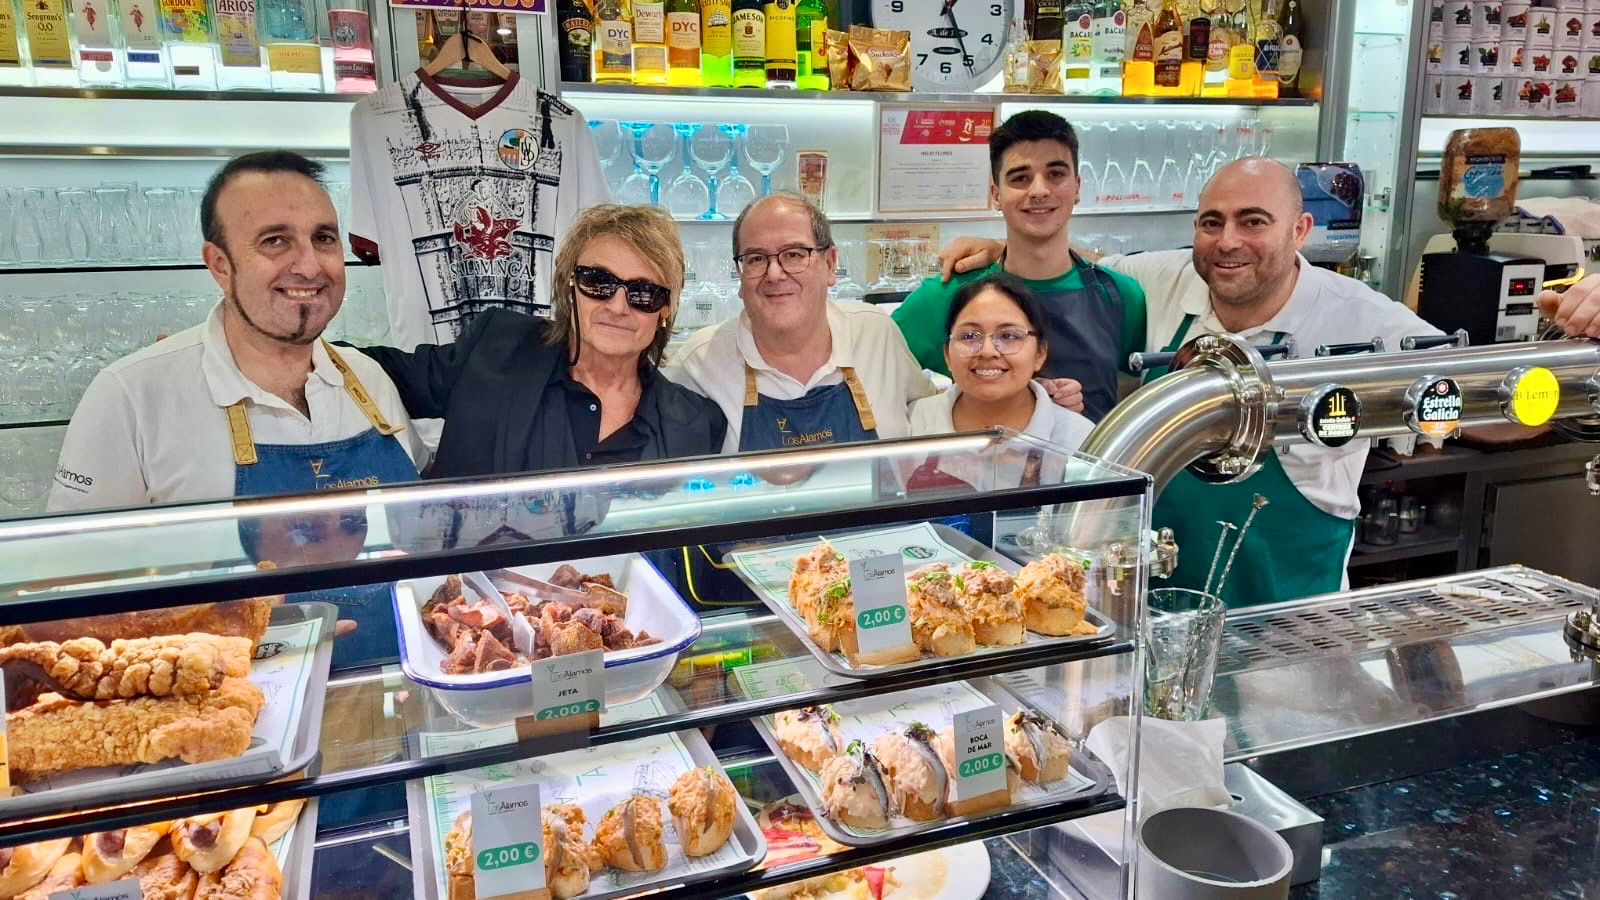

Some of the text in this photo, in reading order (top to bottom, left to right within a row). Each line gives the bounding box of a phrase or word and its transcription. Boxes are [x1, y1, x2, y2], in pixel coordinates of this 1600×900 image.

[891, 1, 904, 12] 9
[990, 4, 1002, 16] 3
[27, 12, 62, 21] Seagram's
[673, 22, 697, 32] DYC
[608, 28, 630, 39] DYC
[981, 33, 994, 45] 4
[917, 54, 928, 66] 7
[962, 55, 975, 67] 5
[940, 62, 952, 74] 6
[1422, 394, 1461, 409] Estrella
[1423, 407, 1459, 421] Galicia
[863, 607, 903, 627] 2,00 €
[557, 688, 579, 698] JETA
[969, 733, 989, 744] BOCA
[967, 741, 993, 754] DE MAR
[963, 754, 1001, 776] 2,00 €
[484, 844, 534, 868] 2,00 €
